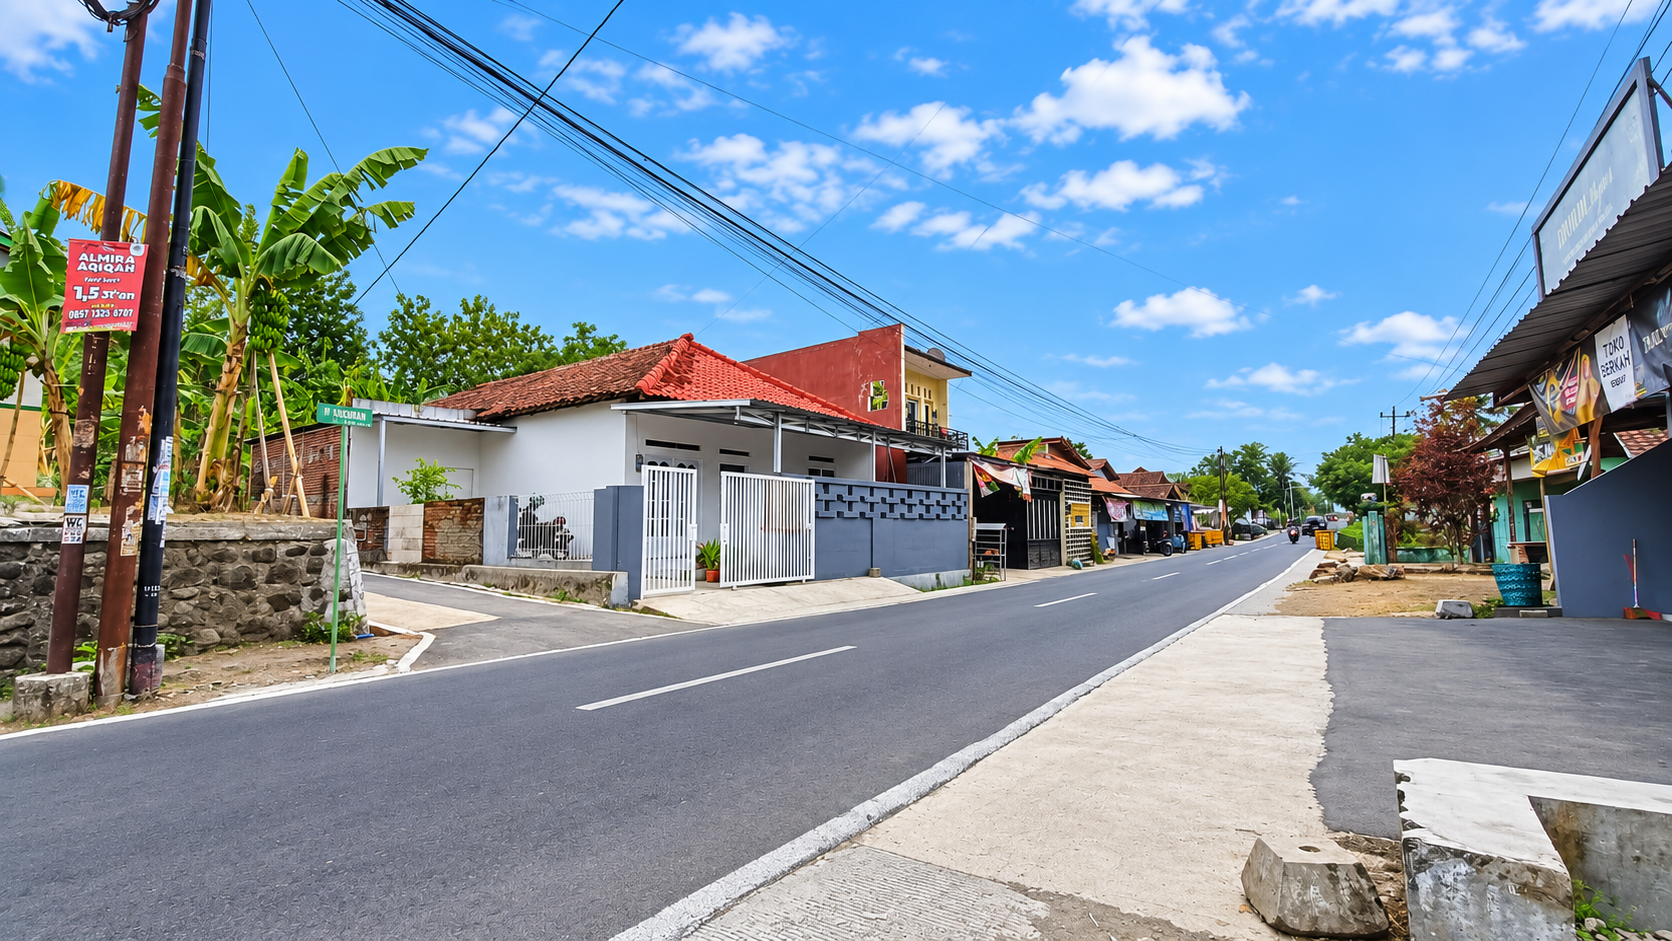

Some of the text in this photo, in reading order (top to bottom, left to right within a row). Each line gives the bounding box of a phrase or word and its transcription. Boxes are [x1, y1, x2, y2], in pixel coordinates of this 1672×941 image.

[78, 252, 135, 264] ALMIRA
[77, 261, 135, 273] AQIQAH
[73, 285, 100, 302] 1,5
[1602, 335, 1624, 358] TOKO
[1600, 350, 1631, 378] BERKAH
[66, 517, 82, 528] WC
